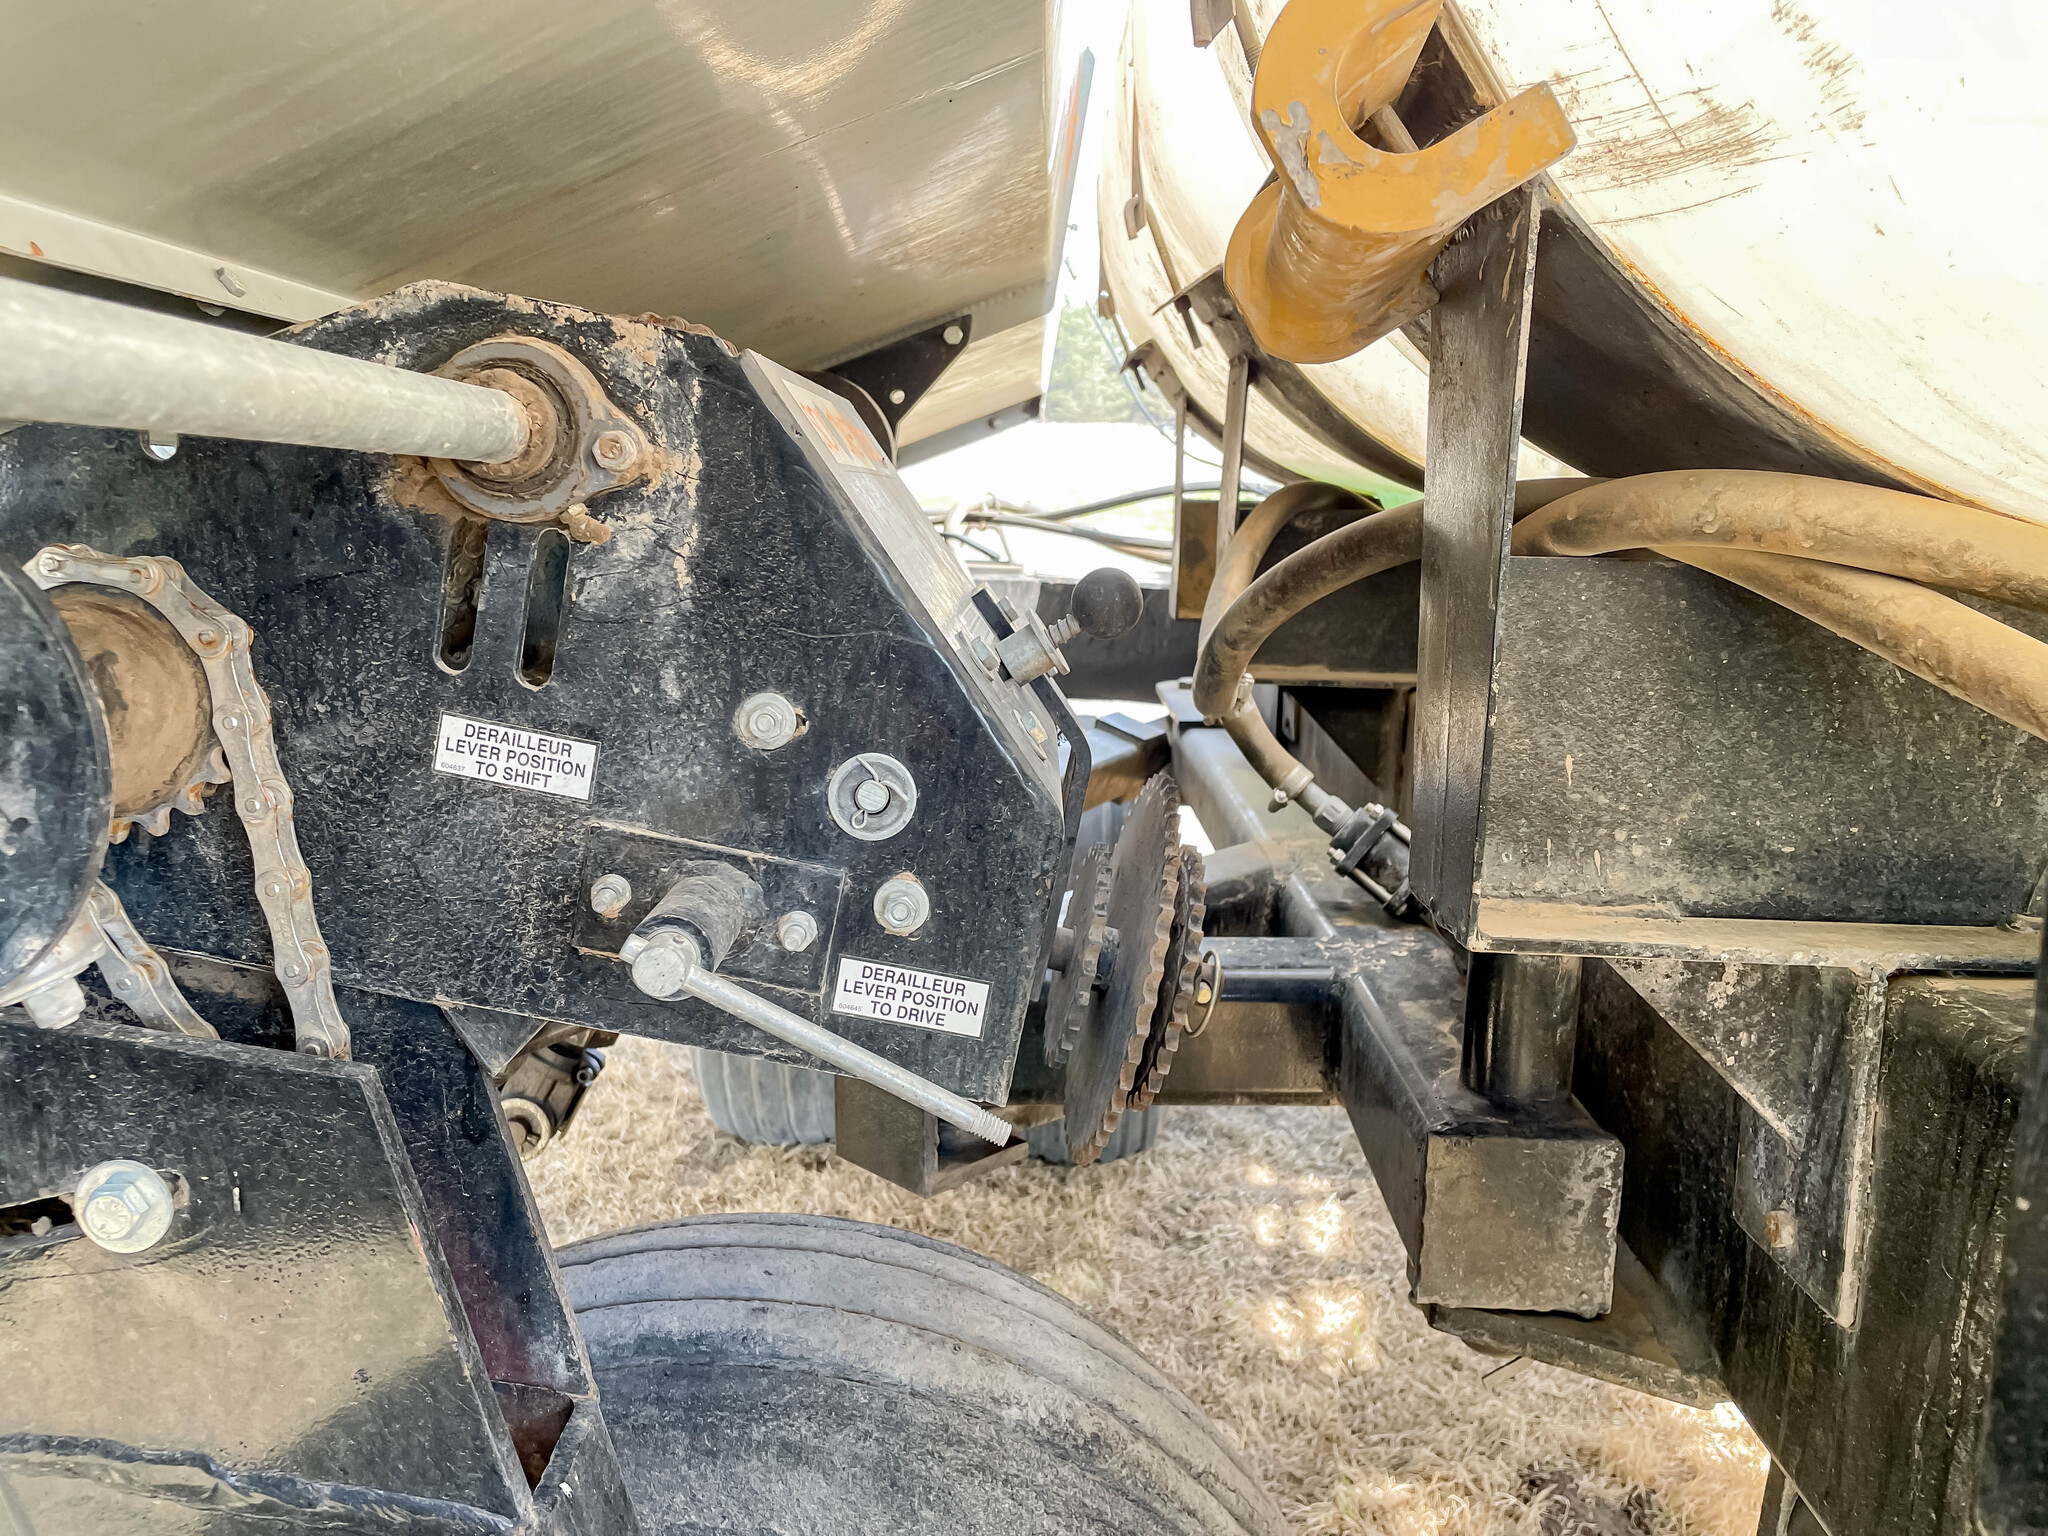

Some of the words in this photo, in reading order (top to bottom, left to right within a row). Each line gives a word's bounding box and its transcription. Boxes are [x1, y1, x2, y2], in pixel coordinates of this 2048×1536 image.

[464, 723, 572, 758] DERAILLEUR
[445, 737, 501, 761] LEVER
[506, 749, 586, 778] POSITION
[475, 760, 498, 778] TO
[502, 766, 552, 788] SHIFT
[843, 979, 897, 1001] LEVER
[901, 989, 979, 1016] POSITION
[861, 965, 966, 997] DERAILLEUR
[870, 1000, 892, 1016] TO
[896, 1006, 946, 1027] DRIVE
